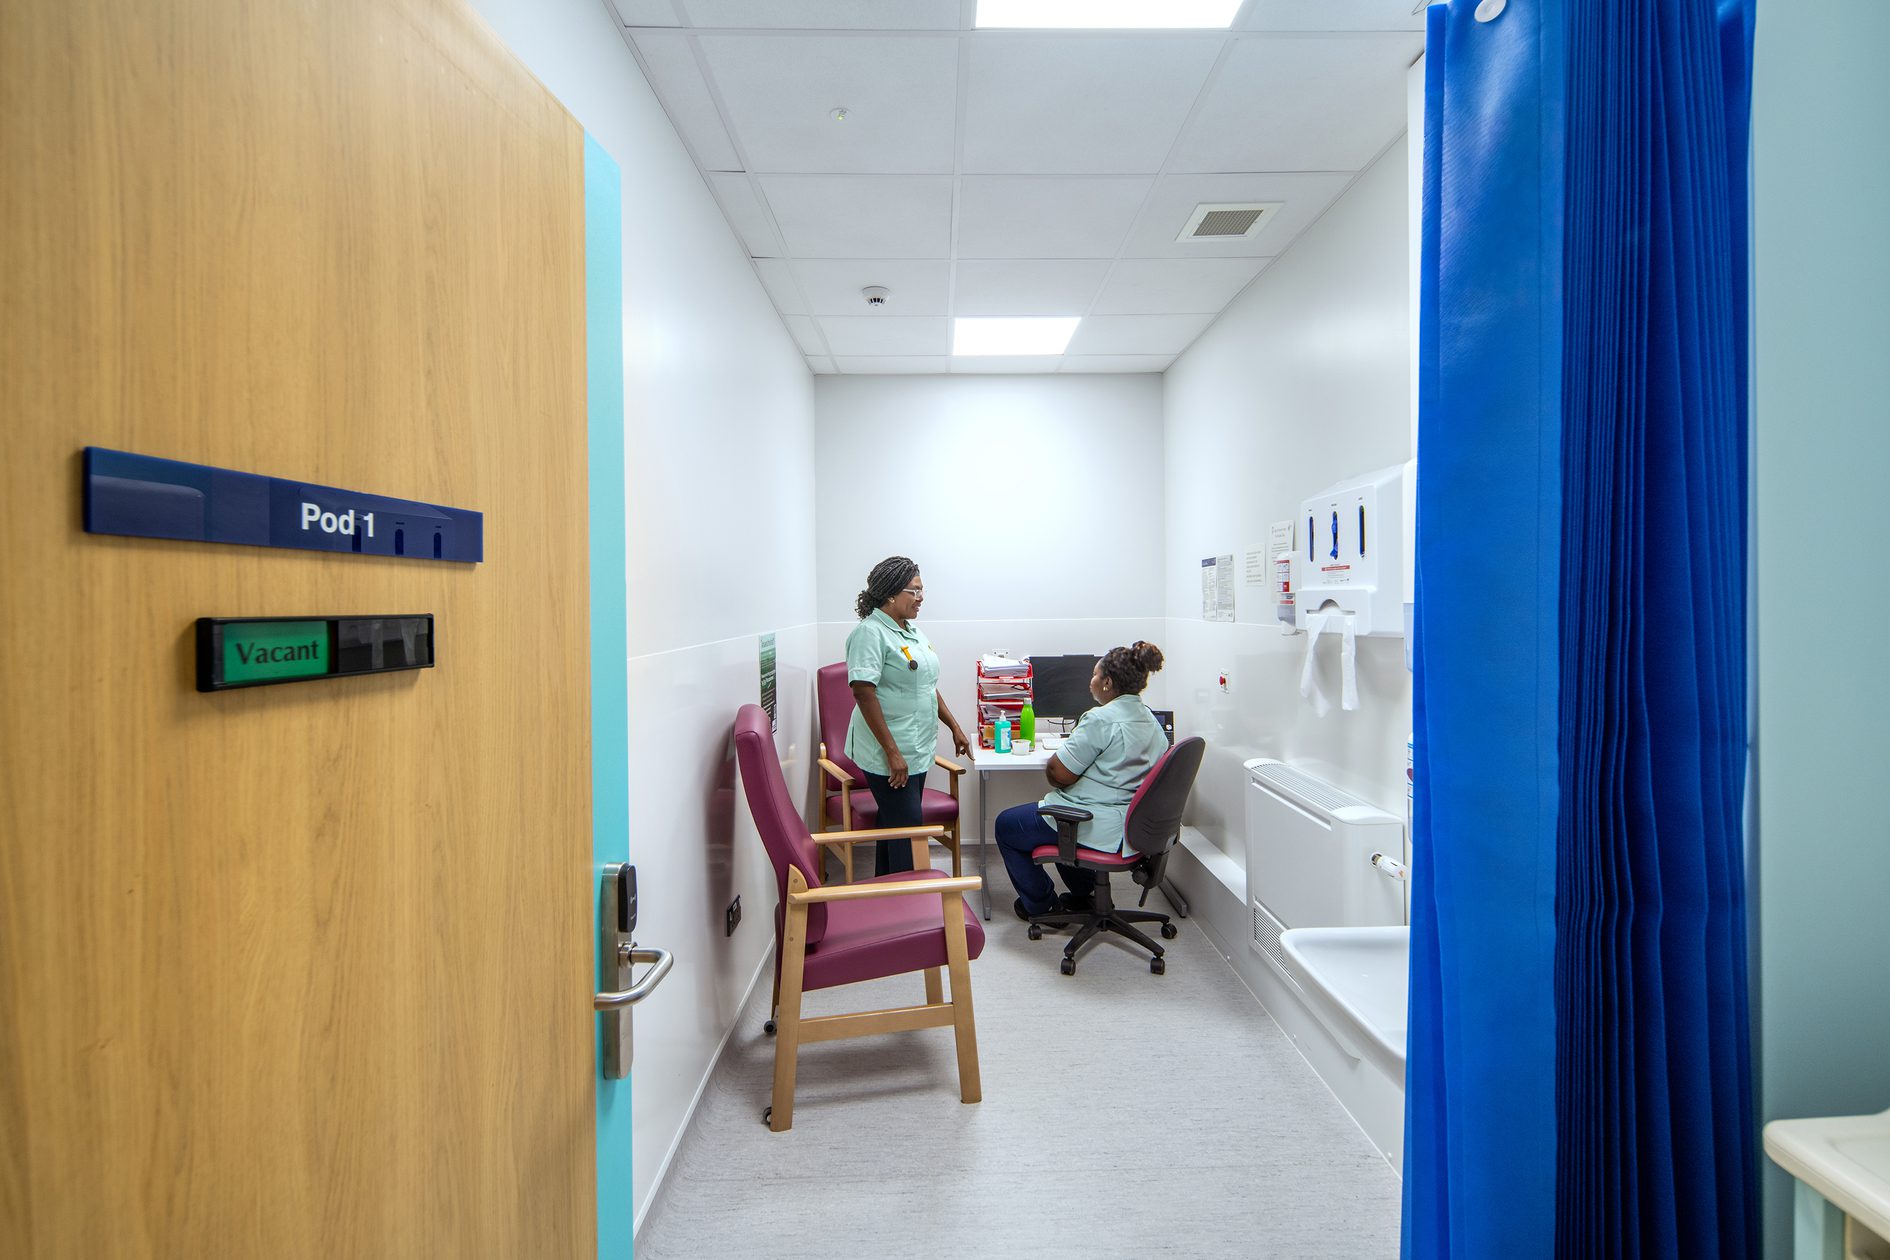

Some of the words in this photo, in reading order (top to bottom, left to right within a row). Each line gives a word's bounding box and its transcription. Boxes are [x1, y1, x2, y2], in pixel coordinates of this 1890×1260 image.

[301, 502, 355, 535] Pod
[363, 512, 374, 537] 1
[236, 640, 320, 665] Vacant
